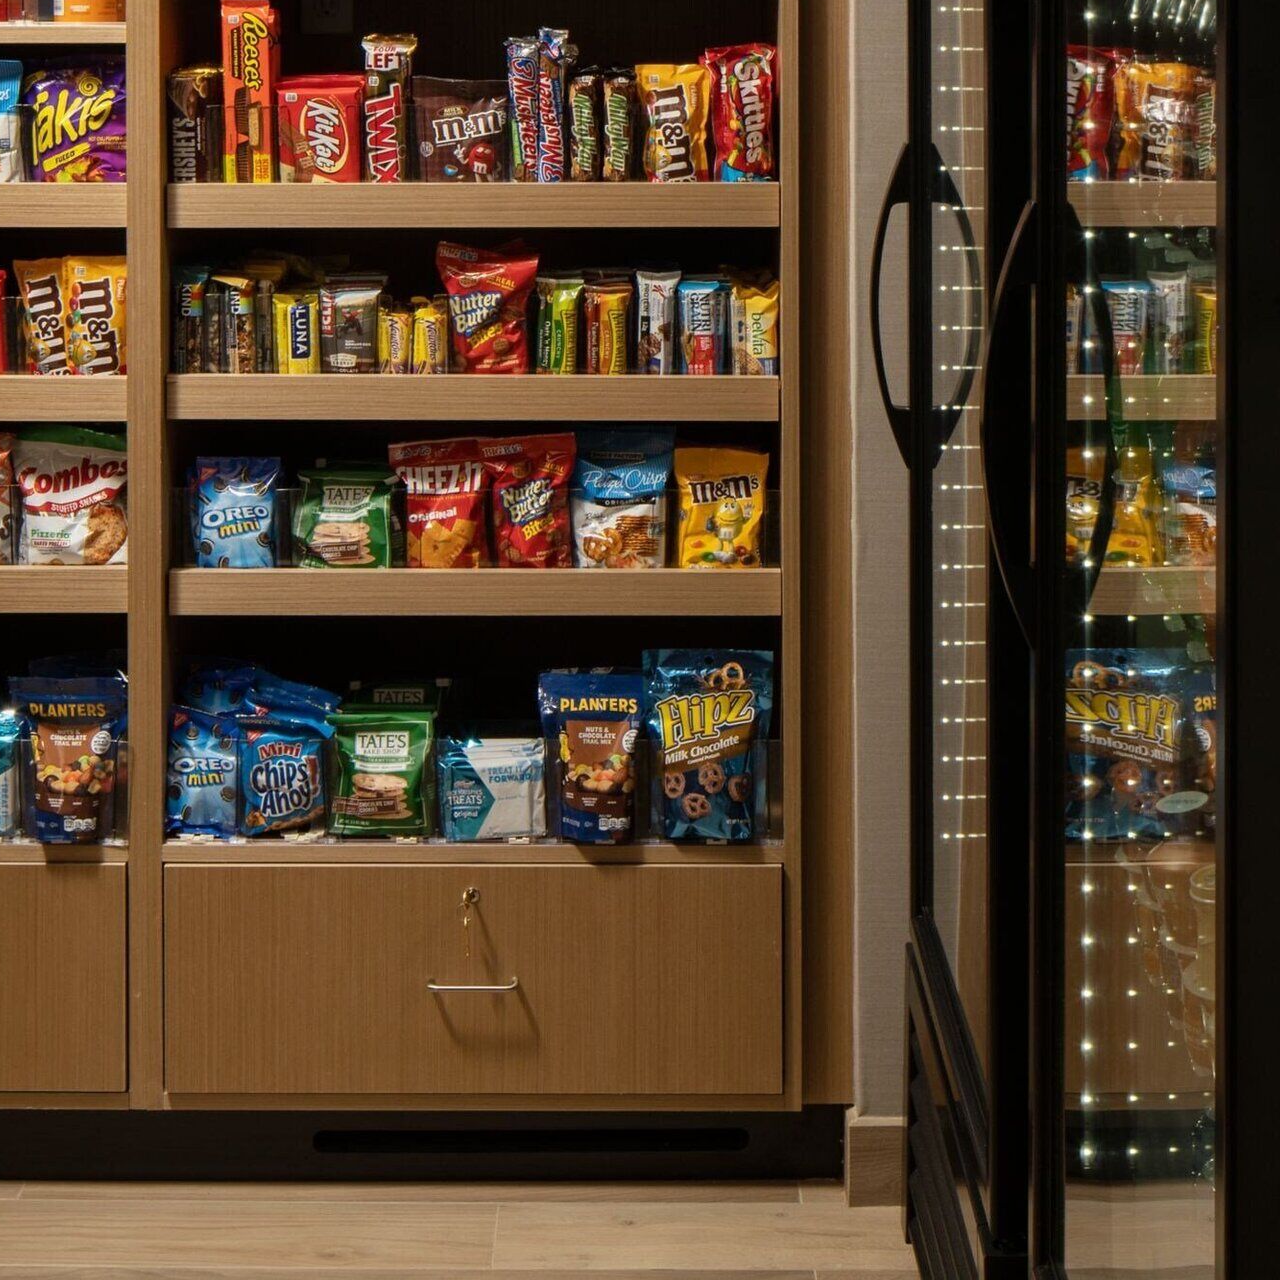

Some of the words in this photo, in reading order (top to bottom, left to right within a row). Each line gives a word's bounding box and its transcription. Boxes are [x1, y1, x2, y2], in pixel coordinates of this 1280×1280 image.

[242, 11, 269, 92] Reese's
[511, 57, 537, 80] 3
[307, 100, 340, 134] Kit
[513, 77, 538, 172] Musketeers
[539, 71, 565, 166] Musketeers
[734, 61, 766, 164] Skittles
[365, 83, 401, 183] TWIX
[173, 118, 196, 183] ERSHEY'S
[308, 130, 340, 169] Kat
[181, 283, 192, 317] KIND
[449, 292, 502, 316] Nutter
[690, 292, 700, 332] GRAIN
[295, 309, 308, 355] LUNA
[751, 312, 771, 355] belVita
[19, 456, 128, 496] Combos
[625, 469, 668, 490] Crisps
[689, 475, 760, 505] m&m's
[50, 500, 79, 512] STUFFED
[326, 486, 372, 501] TATE'S
[502, 478, 550, 507] Nutter
[510, 489, 554, 522] Butter
[605, 498, 646, 506] ORIGINAL
[203, 506, 268, 529] OREO
[219, 520, 261, 539] mini
[30, 528, 71, 539] Pizzeria
[29, 702, 107, 718] PLANTERS
[559, 697, 638, 714] PLANTERS
[656, 690, 755, 751] Flipz
[258, 741, 303, 759] Mini
[357, 734, 407, 749] TATE'S
[578, 732, 617, 740] CHOCOLATE
[664, 750, 689, 766] Milk
[690, 735, 740, 758] Chocolate
[173, 758, 236, 774] OREO
[186, 771, 225, 788] mini
[250, 760, 308, 794] Chips
[447, 795, 483, 806] TREATS
[453, 809, 478, 819] Original
